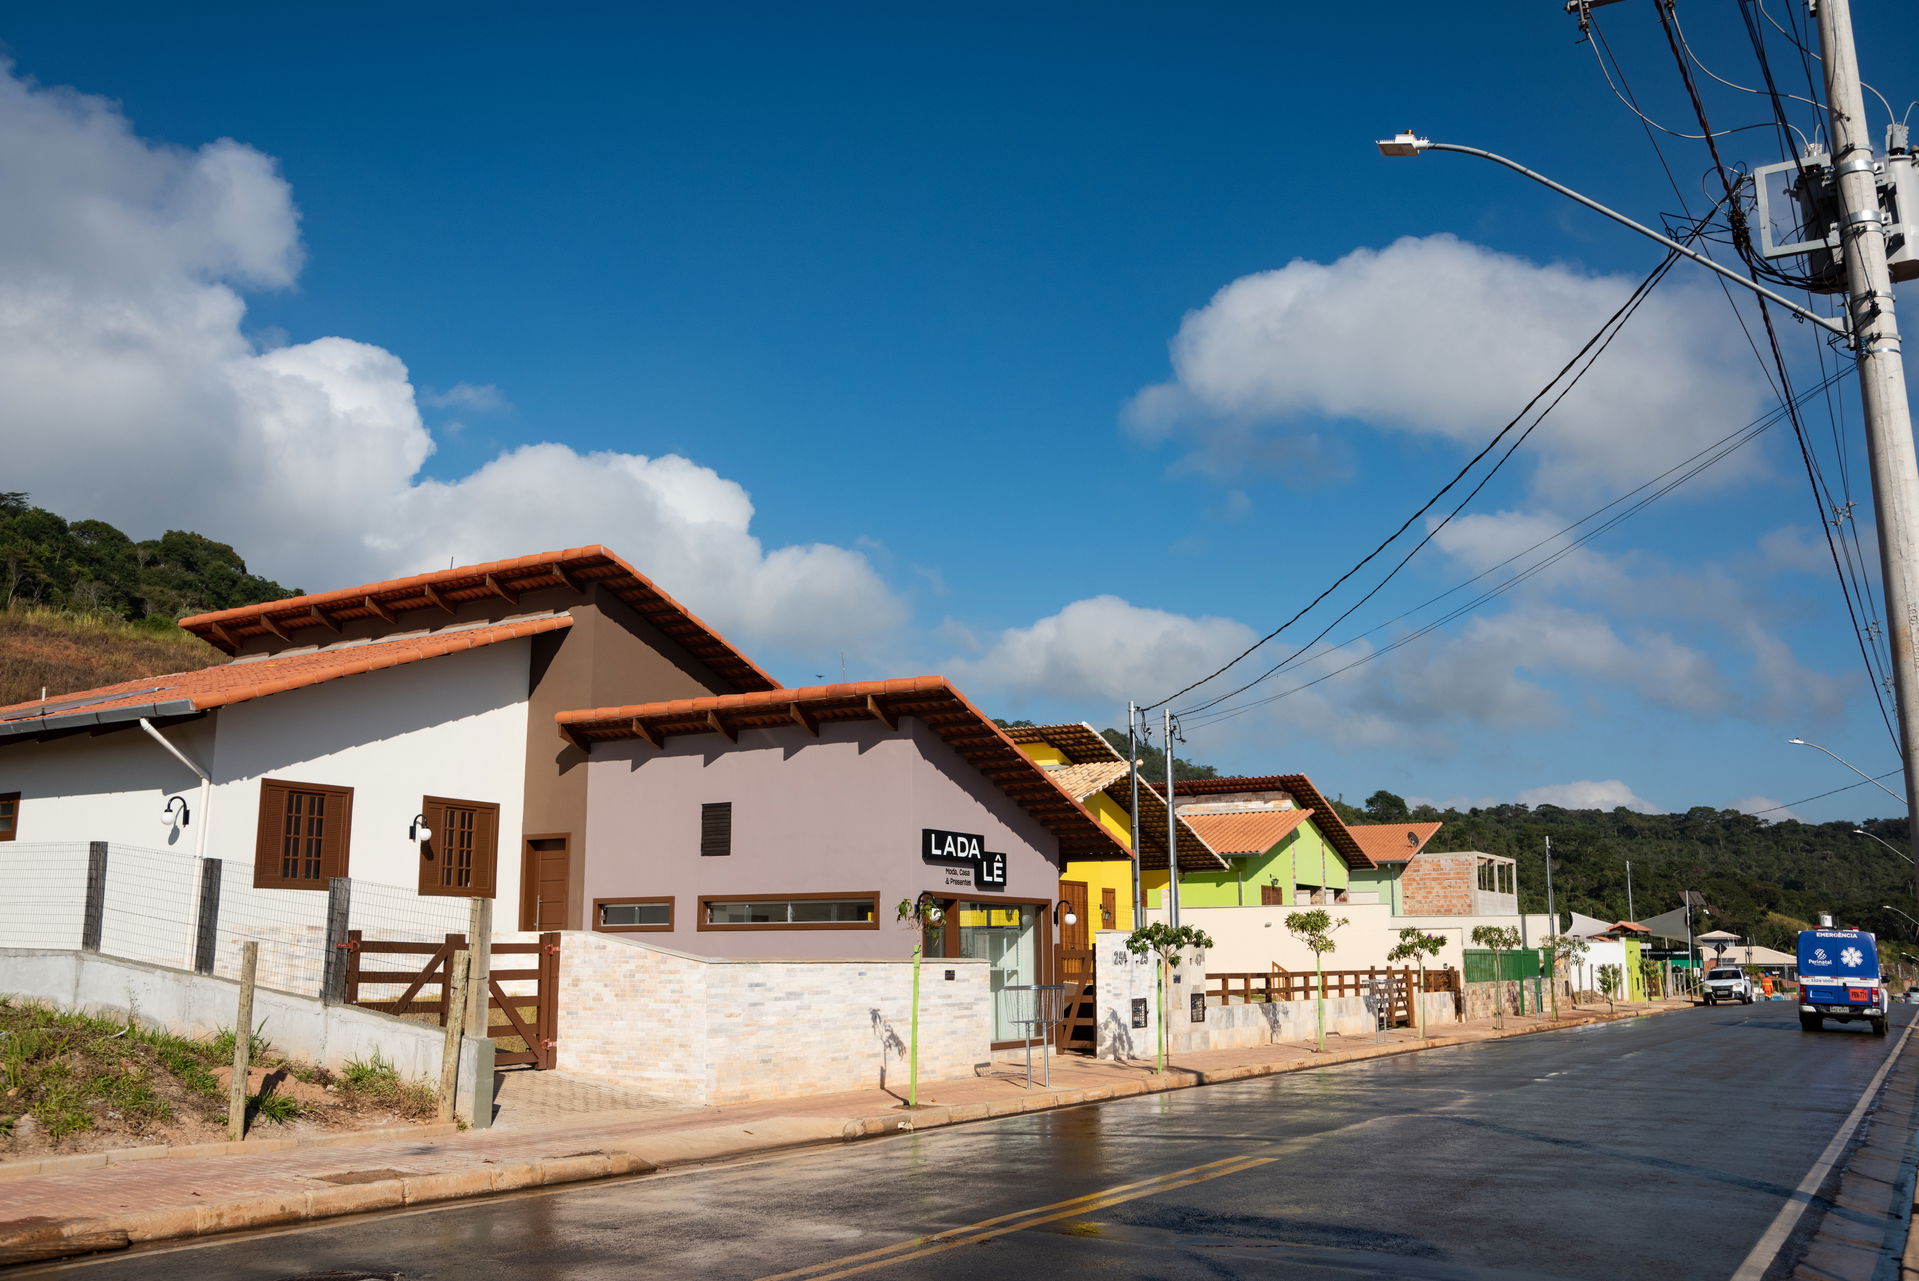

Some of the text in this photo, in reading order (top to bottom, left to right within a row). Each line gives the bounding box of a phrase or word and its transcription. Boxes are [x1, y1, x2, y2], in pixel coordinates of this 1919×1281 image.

[932, 834, 981, 859] LADA
[945, 868, 970, 876] Moda, Casa
[983, 855, 1003, 882] LÊ
[950, 878, 971, 886] Presentes
